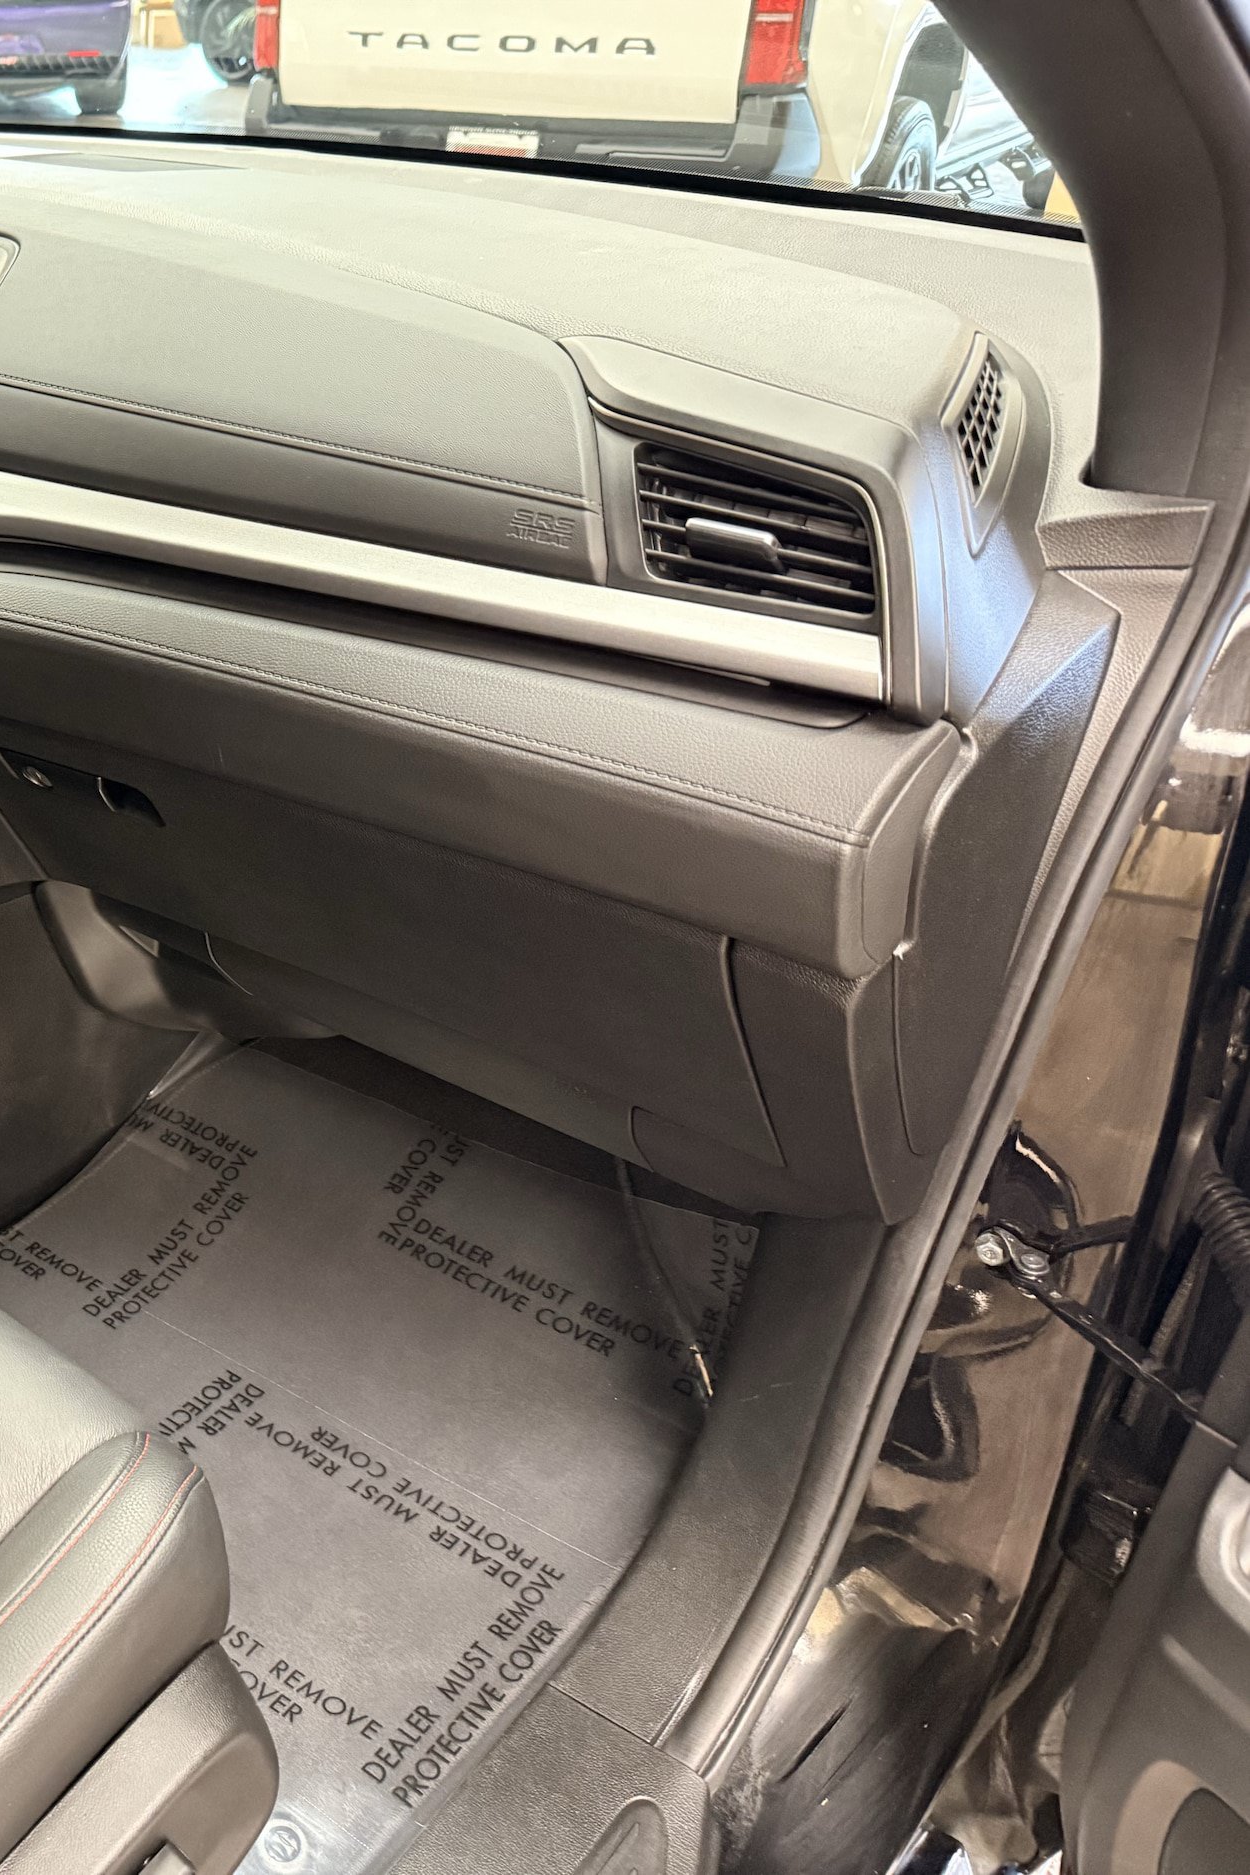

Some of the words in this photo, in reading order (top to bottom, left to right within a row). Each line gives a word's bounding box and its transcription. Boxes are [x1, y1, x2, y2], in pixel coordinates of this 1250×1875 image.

[348, 31, 656, 56] TACOMA
[511, 508, 576, 533] SRS
[158, 1128, 226, 1171] DEALER
[383, 1138, 437, 1194] COVER
[82, 1268, 148, 1318] DEALER
[147, 1218, 194, 1266] MUST
[192, 1144, 259, 1216] REMOVE
[378, 1170, 444, 1247] REMOVE
[24, 1241, 104, 1293] REMOVE
[102, 1248, 199, 1330] PROTECTIVE
[197, 1191, 250, 1246] COVER
[413, 1218, 494, 1269] DEALER
[503, 1265, 575, 1306] MUST
[580, 1301, 685, 1360] REMOVE
[398, 1237, 531, 1313] PROTECTIVE
[535, 1308, 616, 1357] COVER
[196, 1382, 266, 1437] DEALER
[244, 1411, 342, 1478] REMOVE
[310, 1426, 387, 1479] COVER
[346, 1478, 420, 1524] MUST
[392, 1477, 539, 1571] PROTECTIVE
[428, 1524, 523, 1589] DEALER
[268, 1659, 384, 1741] REMOVE
[360, 1704, 442, 1785] DEALER
[436, 1640, 494, 1703] MUST
[487, 1563, 566, 1642] REMOVE
[391, 1681, 507, 1809] PROTECTIVE
[499, 1618, 564, 1683] COVER
